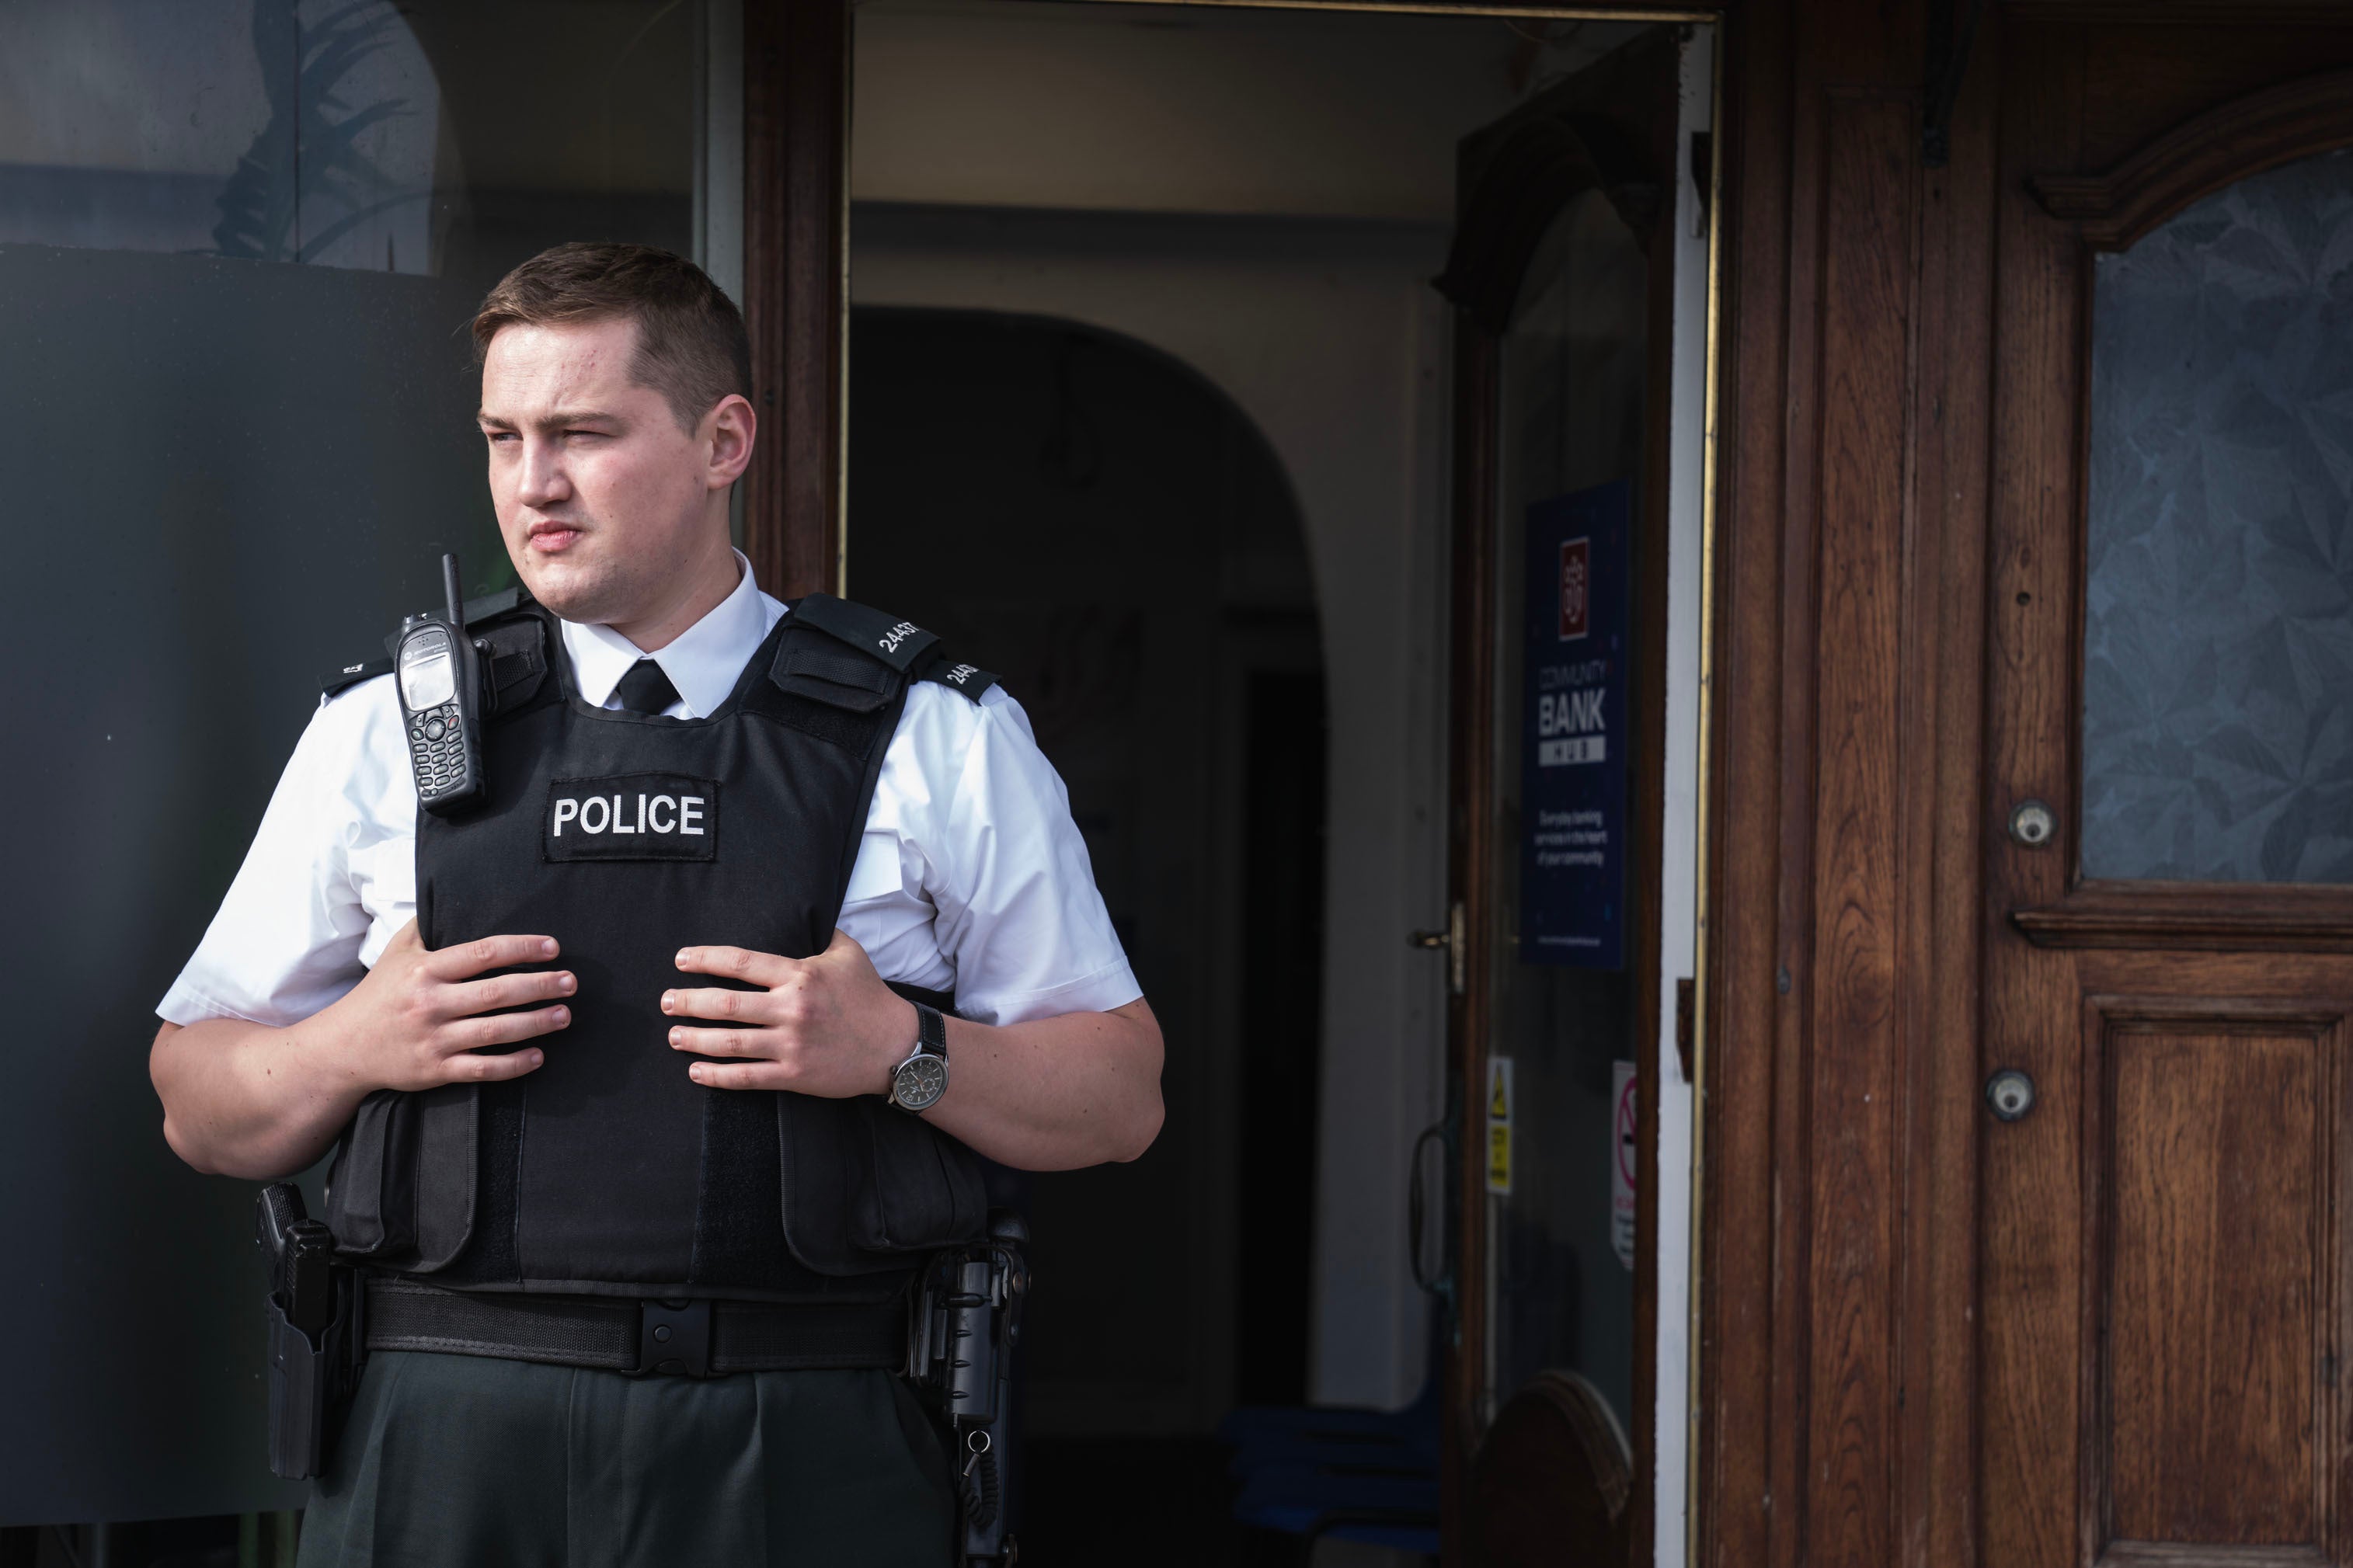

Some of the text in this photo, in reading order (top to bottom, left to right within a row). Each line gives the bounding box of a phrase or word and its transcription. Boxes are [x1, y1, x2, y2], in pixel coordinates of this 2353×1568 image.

[879, 621, 920, 653] 24437
[1539, 687, 1606, 736] BANK
[553, 794, 705, 837] POLICE
